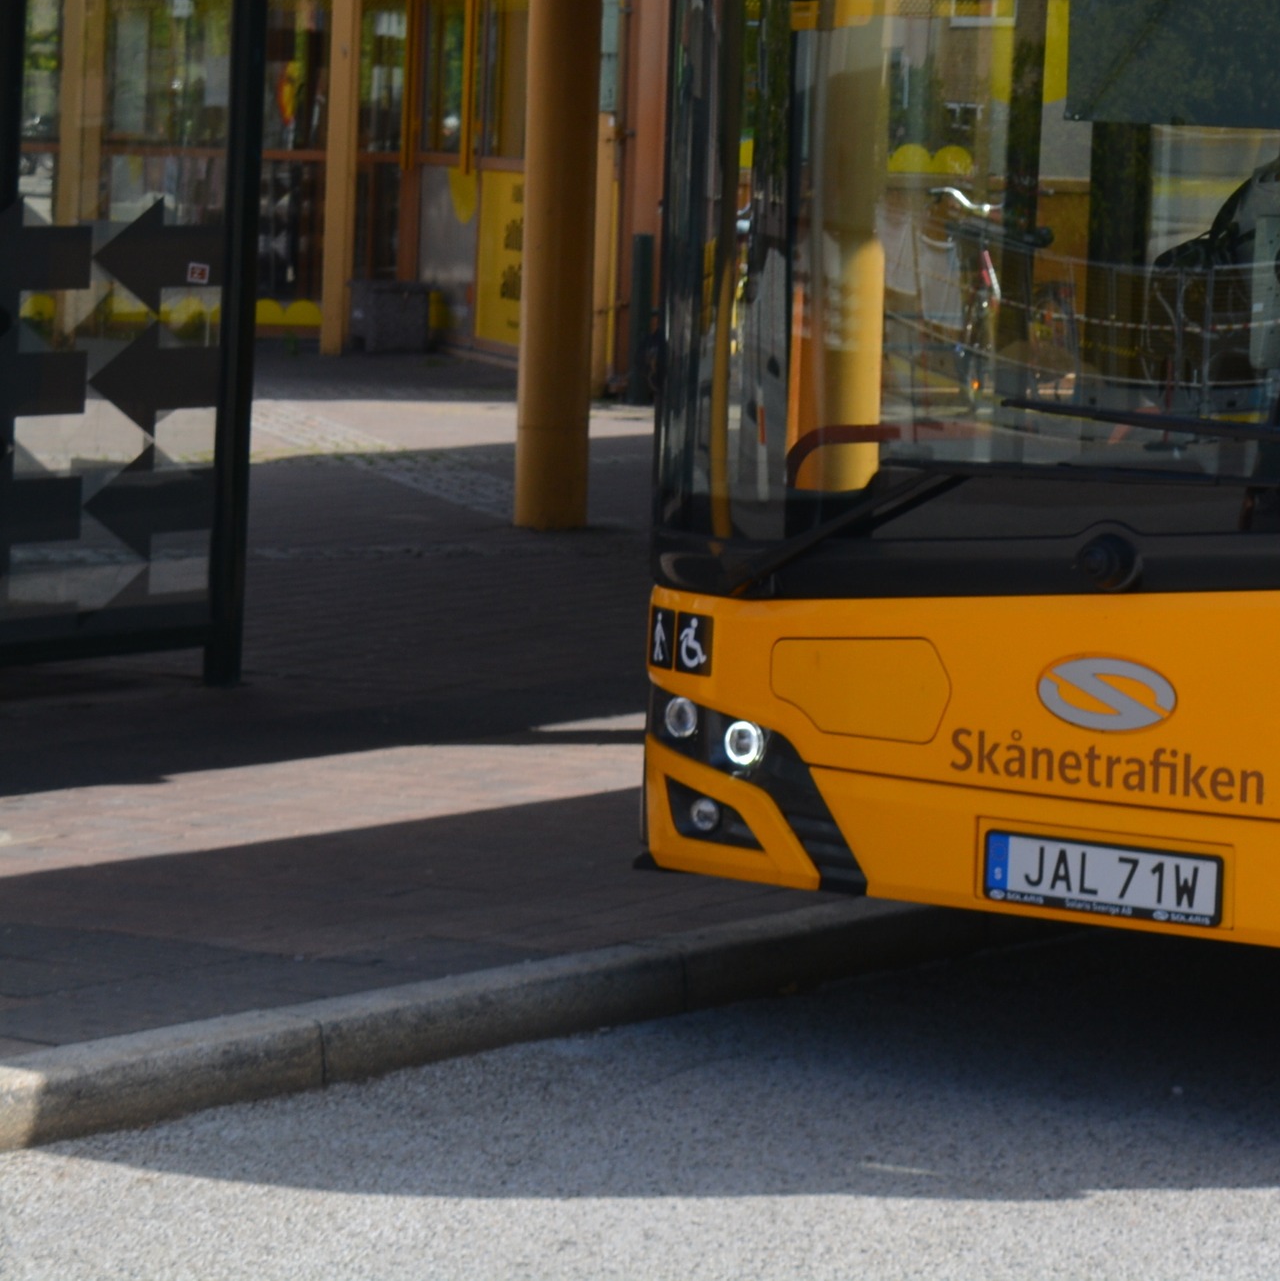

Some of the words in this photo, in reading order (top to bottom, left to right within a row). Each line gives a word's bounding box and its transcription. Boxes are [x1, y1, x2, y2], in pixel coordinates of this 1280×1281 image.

[949, 727, 1266, 806] Skånetrafiken
[1024, 846, 1098, 896] JAL
[1118, 856, 1199, 909] 71W
